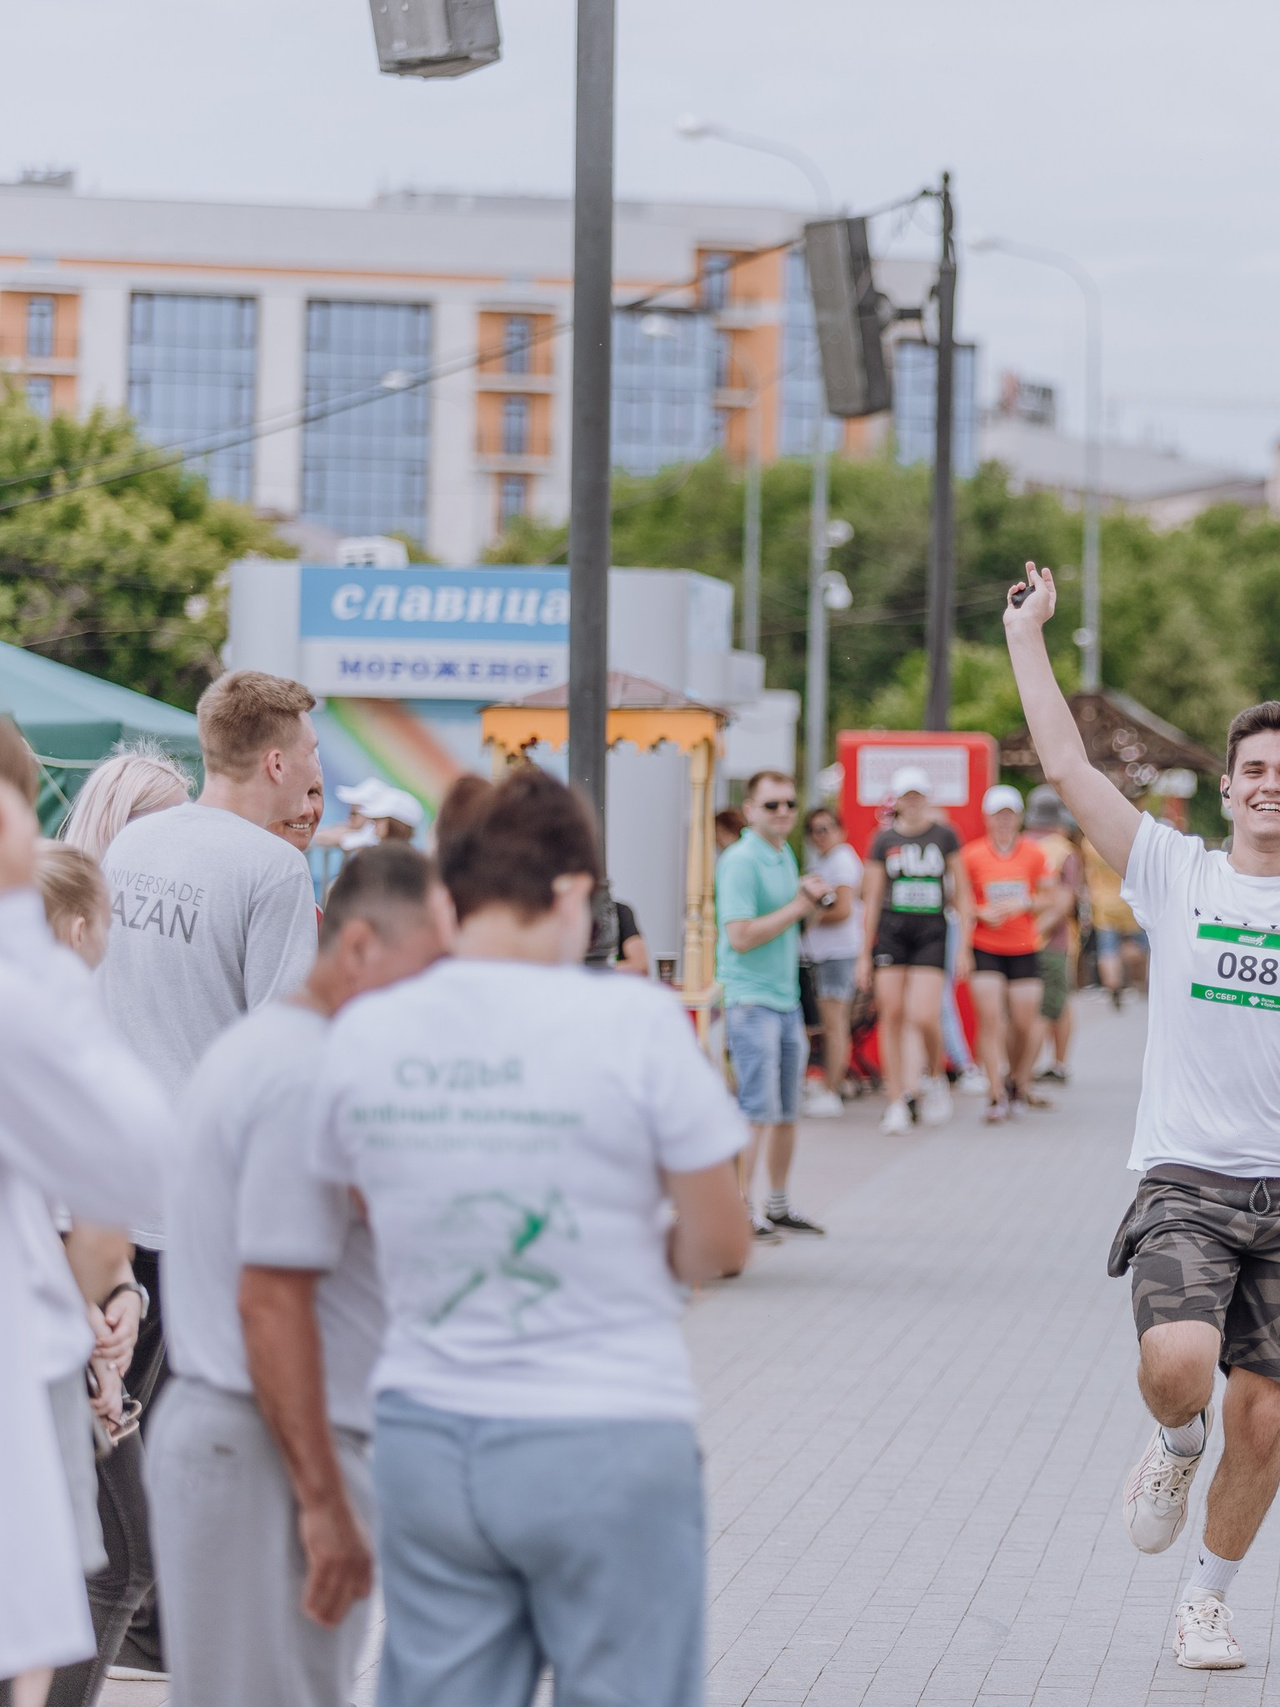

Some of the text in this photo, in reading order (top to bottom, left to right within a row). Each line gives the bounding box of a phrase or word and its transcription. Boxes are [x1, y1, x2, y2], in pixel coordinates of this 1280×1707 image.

[339, 656, 554, 682] МОРОЖЕНОЕ
[109, 868, 205, 907] NIVERSIADE
[111, 890, 199, 945] AZAN
[1217, 952, 1279, 985] 088
[1215, 992, 1237, 1001] СБЕР
[394, 1056, 524, 1090] СУДЬЯ
